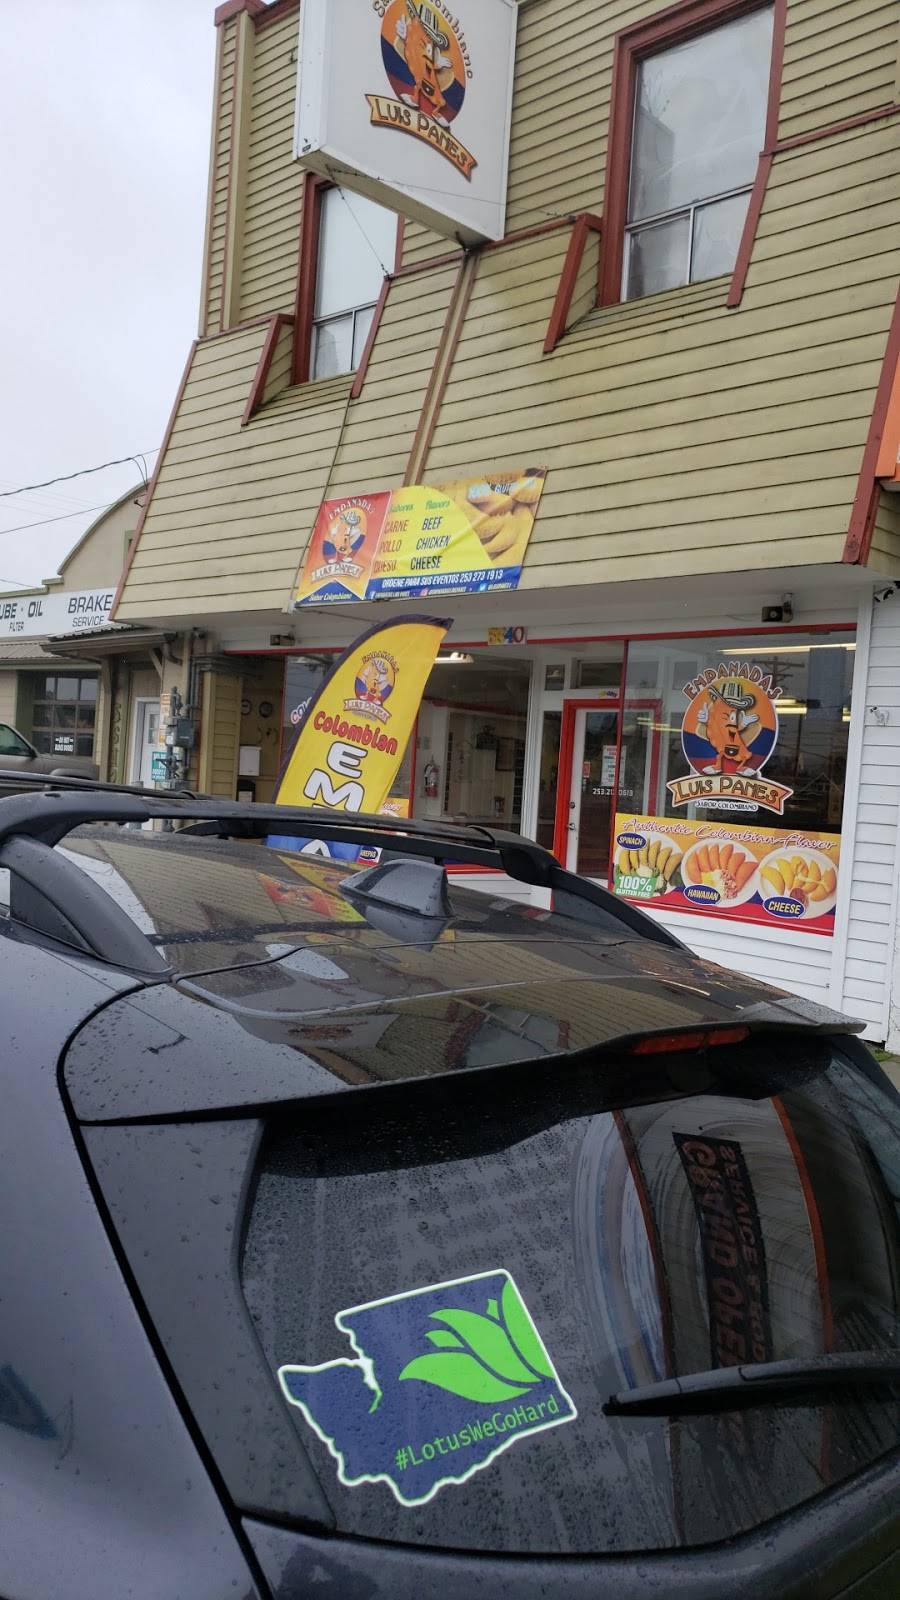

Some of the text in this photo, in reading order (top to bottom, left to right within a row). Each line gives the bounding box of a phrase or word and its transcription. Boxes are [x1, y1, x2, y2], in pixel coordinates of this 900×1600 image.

[375, 98, 467, 167] LUIS PANES
[385, 516, 443, 533] CARNE BEEF
[380, 535, 451, 553] POLLO CHICKEN
[410, 555, 443, 570] CHEESE
[405, 578, 421, 587] PARA
[420, 577, 433, 586] SUS
[432, 574, 459, 585] EVENTOS
[460, 573, 473, 583] 253
[486, 570, 503, 580] 1913
[0, 601, 43, 619] UBE OIL
[68, 594, 113, 614] BRAKE
[9, 621, 24, 632] FILTER
[72, 616, 104, 627] SERVICE
[683, 661, 782, 701] EMPANADAS
[314, 710, 399, 755] Colombian
[677, 775, 779, 804] LUIS PANES
[618, 836, 643, 846] SPINACH
[622, 818, 694, 835] Authentic
[695, 824, 782, 846] Colombian
[619, 875, 653, 892] 100%
[768, 902, 802, 915] CHEESE
[395, 1394, 560, 1470] #LotusWeGoHard
